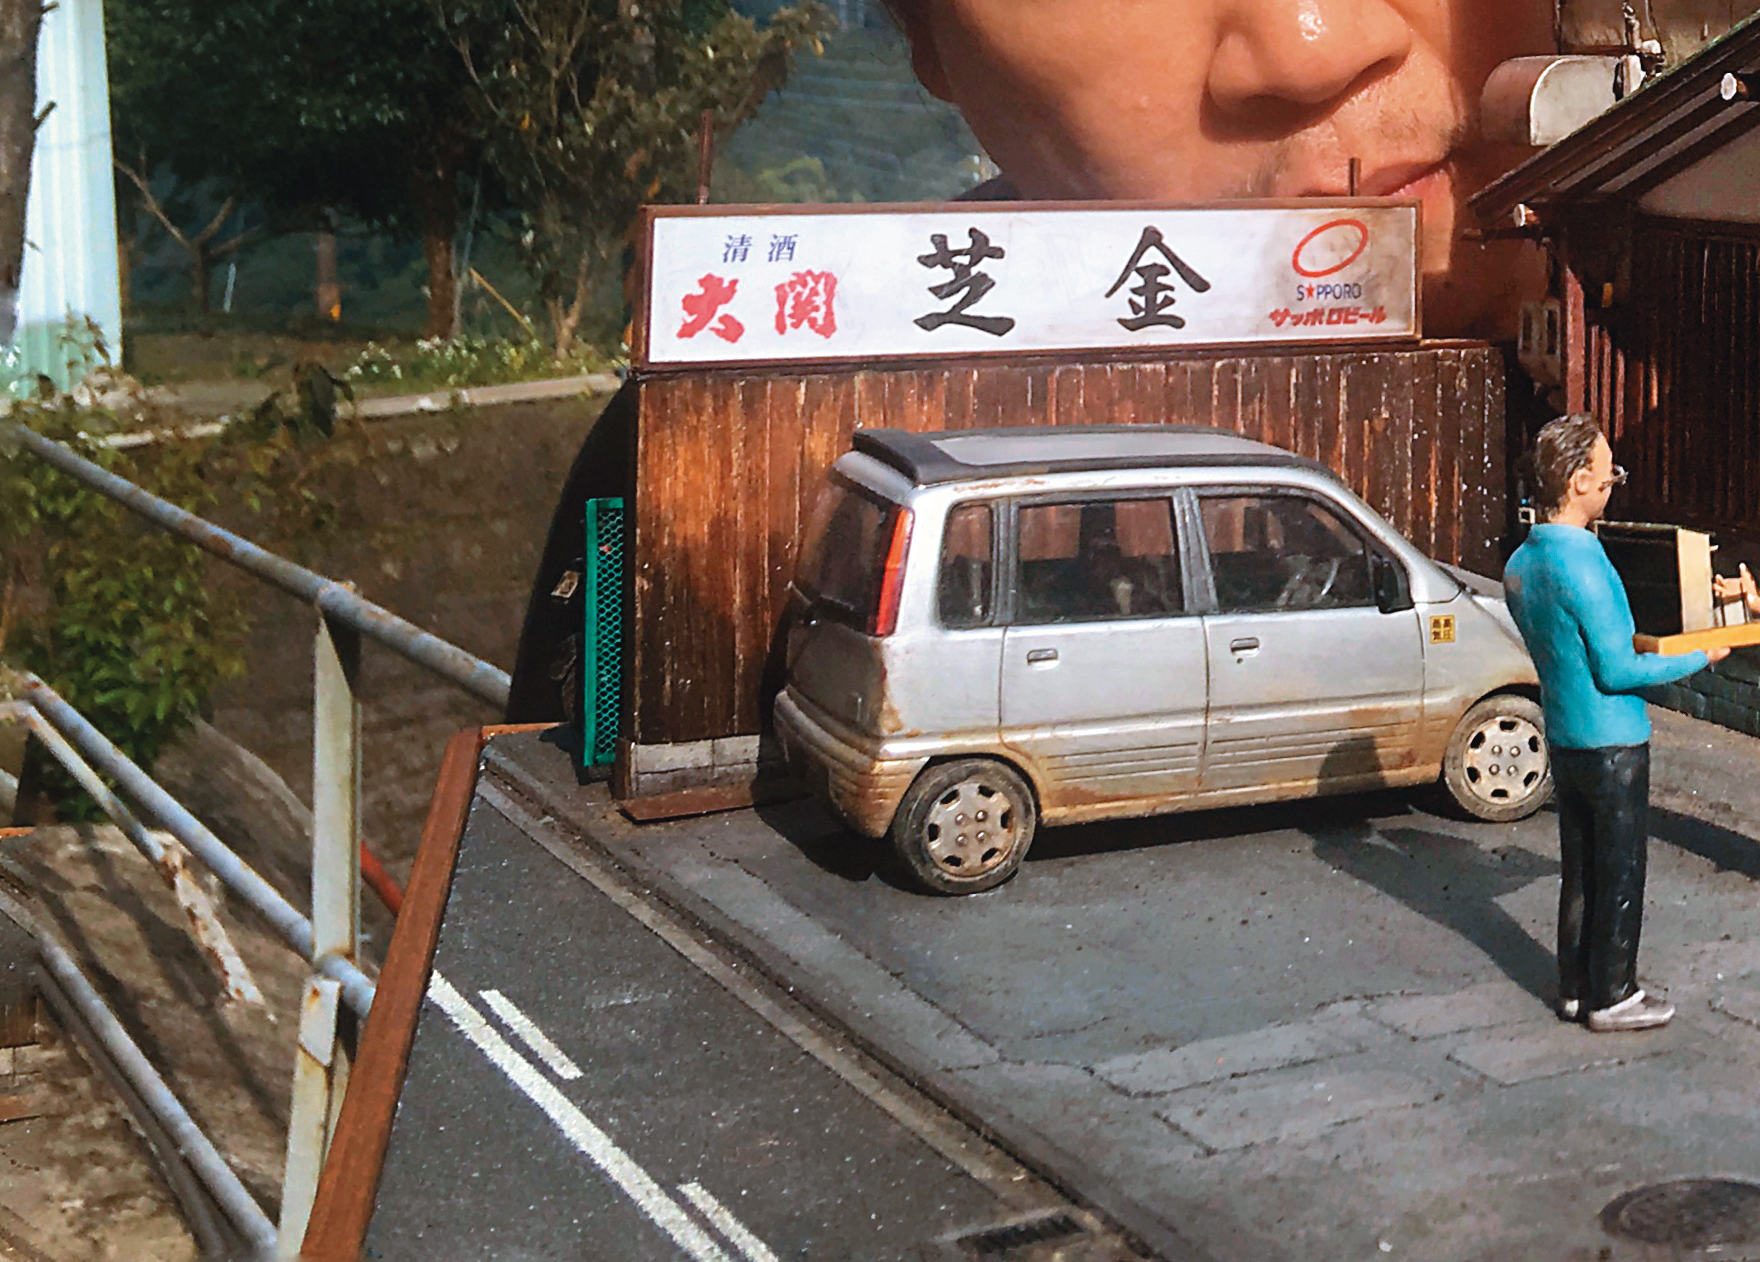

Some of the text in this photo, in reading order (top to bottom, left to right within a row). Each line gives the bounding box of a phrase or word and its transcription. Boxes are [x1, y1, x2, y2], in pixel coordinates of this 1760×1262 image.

[722, 234, 799, 263] 清酒
[676, 269, 839, 343] 大関
[913, 225, 1211, 337] 芝金
[1268, 305, 1388, 327] サッポロビール
